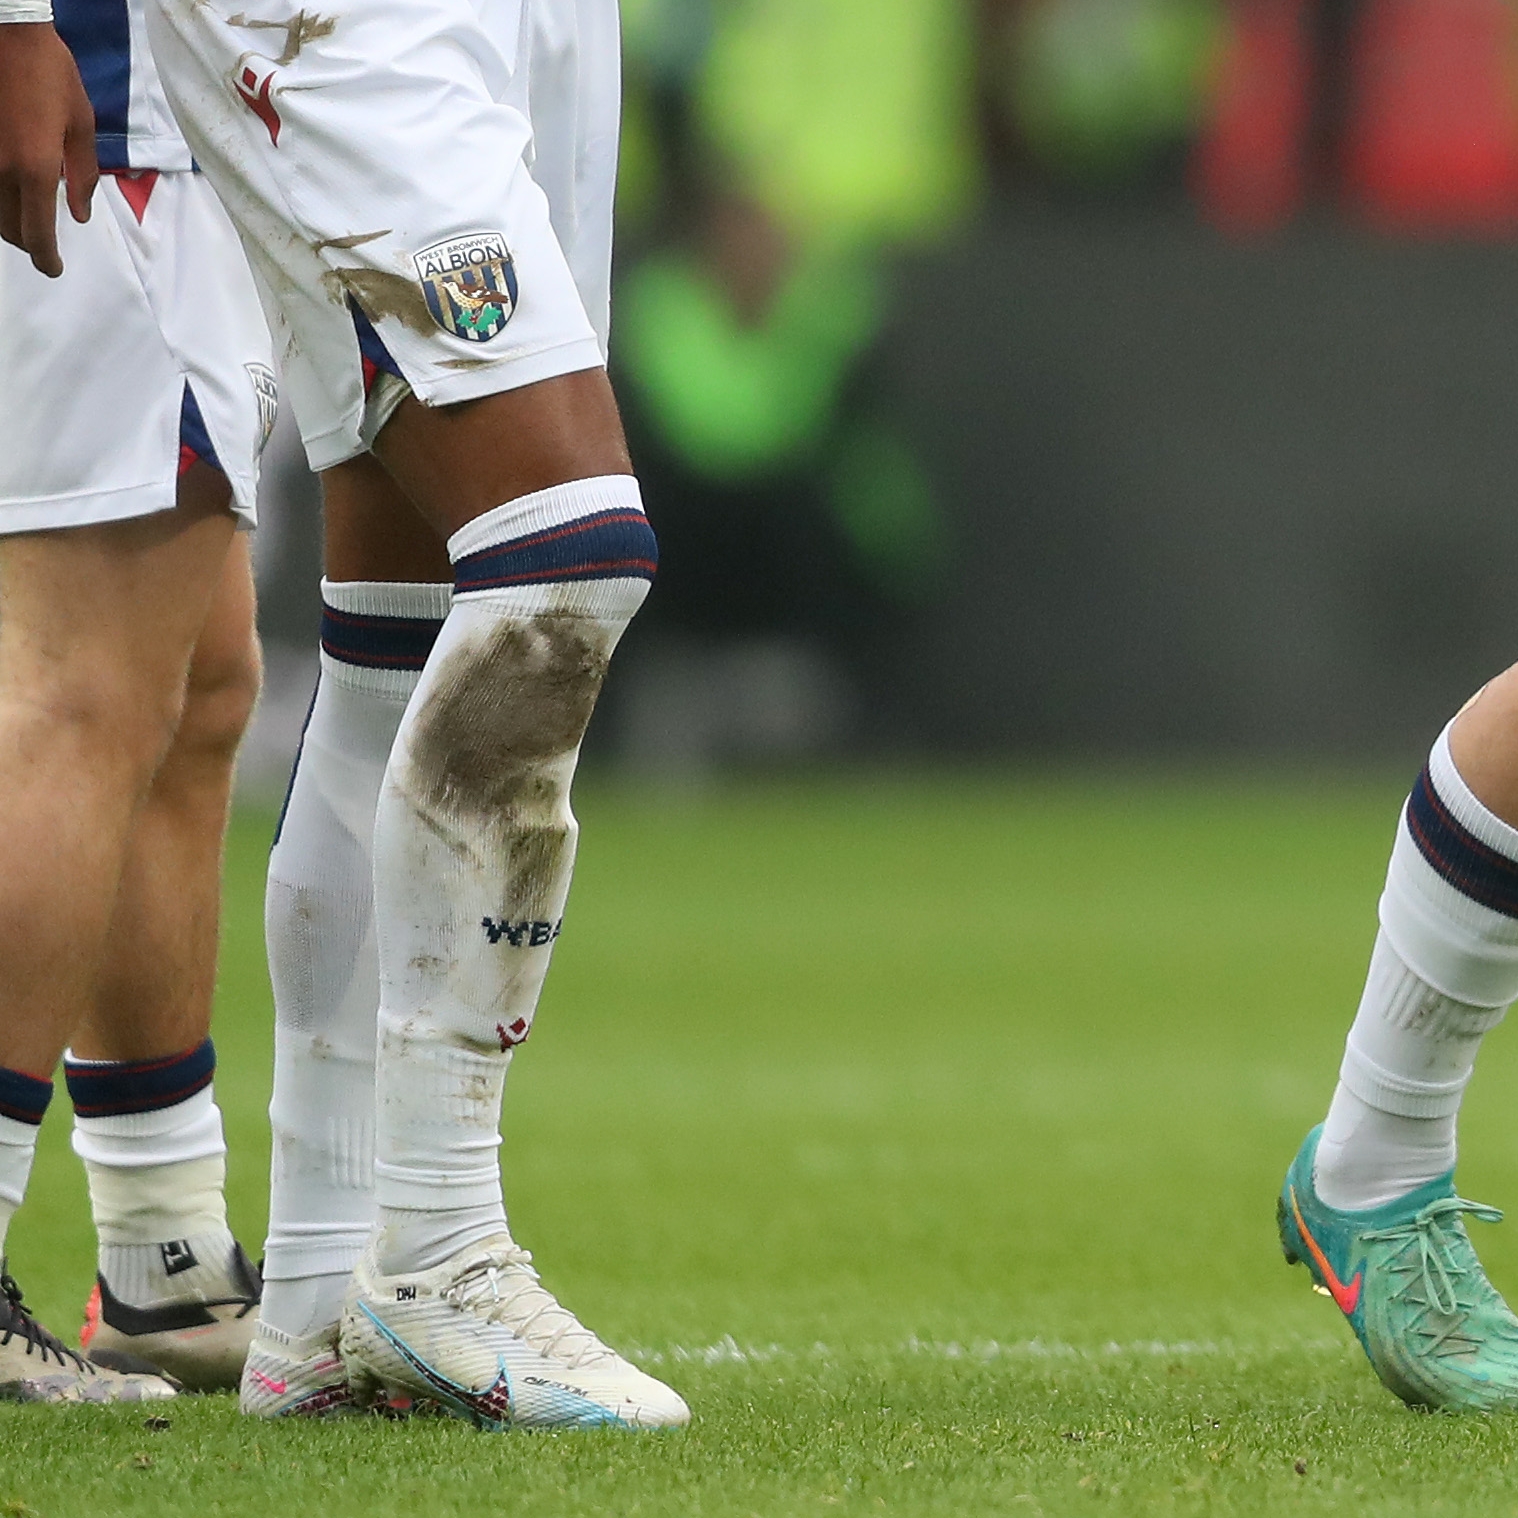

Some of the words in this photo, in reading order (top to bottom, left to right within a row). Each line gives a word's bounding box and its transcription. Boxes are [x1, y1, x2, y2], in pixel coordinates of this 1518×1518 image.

[419, 249, 444, 262] WEST
[447, 236, 499, 254] BROMWICH
[425, 243, 505, 278] ALBION
